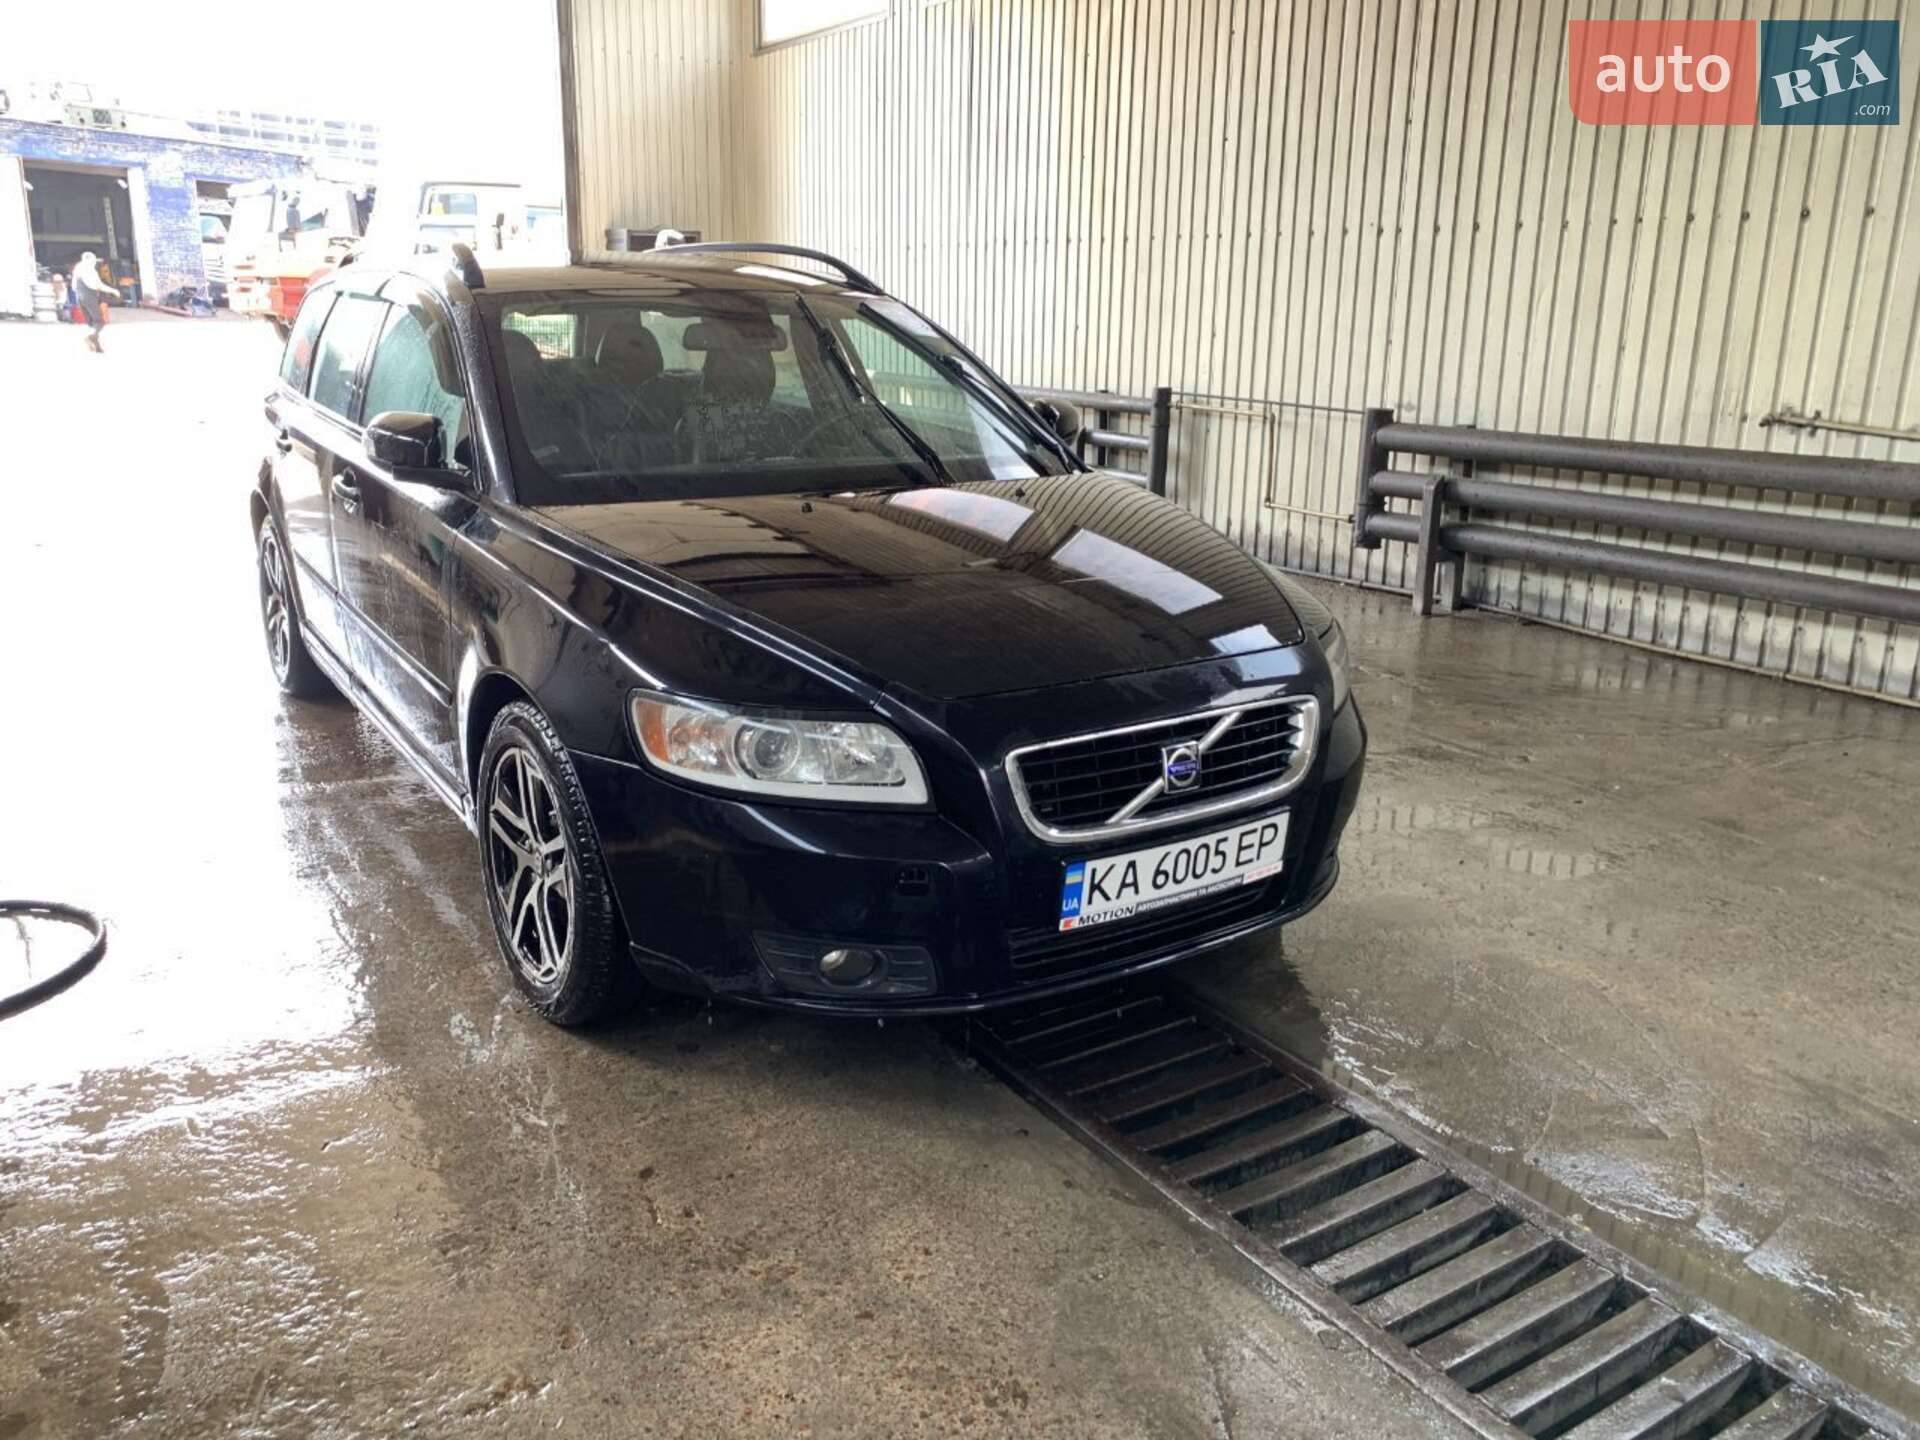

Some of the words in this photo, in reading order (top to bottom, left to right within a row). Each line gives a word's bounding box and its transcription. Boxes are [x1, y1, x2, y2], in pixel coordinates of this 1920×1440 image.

[1087, 859, 1139, 905] KA
[1152, 837, 1228, 890] 6005
[1234, 822, 1278, 868] EP
[1062, 897, 1079, 912] UA
[1078, 905, 1134, 926] MOTION
